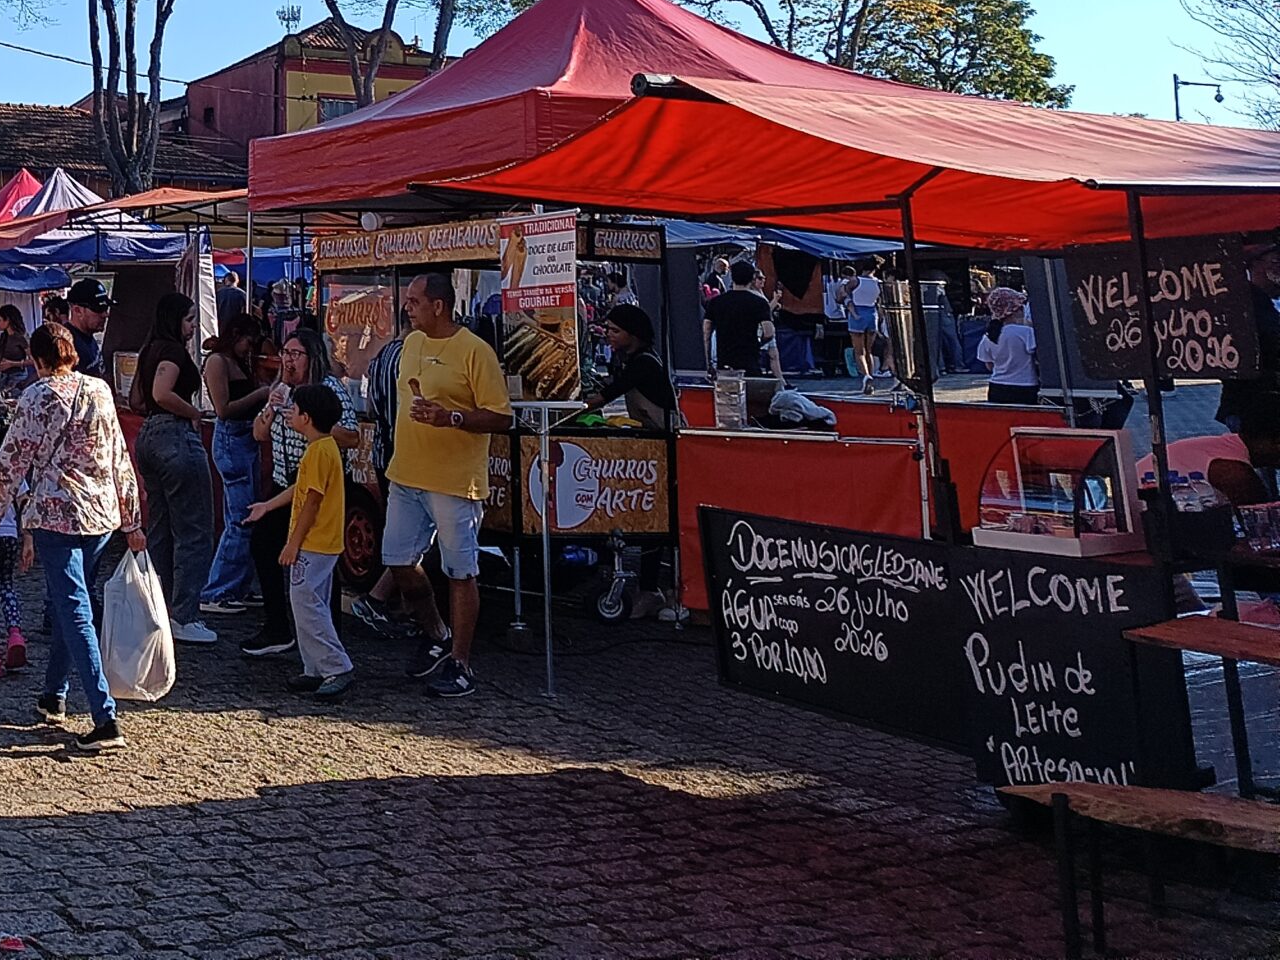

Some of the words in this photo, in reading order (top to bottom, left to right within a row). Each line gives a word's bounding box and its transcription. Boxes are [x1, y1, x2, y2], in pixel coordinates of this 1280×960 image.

[524, 217, 576, 235] TRADICIONAL
[594, 230, 657, 252] CHURROS
[319, 236, 370, 259] DELICIOSOS
[374, 230, 424, 260] CHURROS
[427, 223, 499, 252] RECHEADOS
[528, 243, 546, 256] DOCE
[547, 243, 557, 254] DE
[557, 241, 575, 253] LEITE
[533, 263, 573, 276] CHOCOLATE
[519, 295, 561, 308] GOURMET
[1105, 313, 1143, 352] 26
[1166, 333, 1240, 372] 2026
[573, 456, 658, 486] CHURROS
[596, 487, 656, 517] ARTE
[722, 578, 778, 630] ÁGUA
[815, 586, 851, 614] 26
[959, 566, 1130, 624] WELCOME
[732, 631, 748, 661] 3
[834, 622, 889, 662] 2026
[1065, 651, 1096, 695] de
